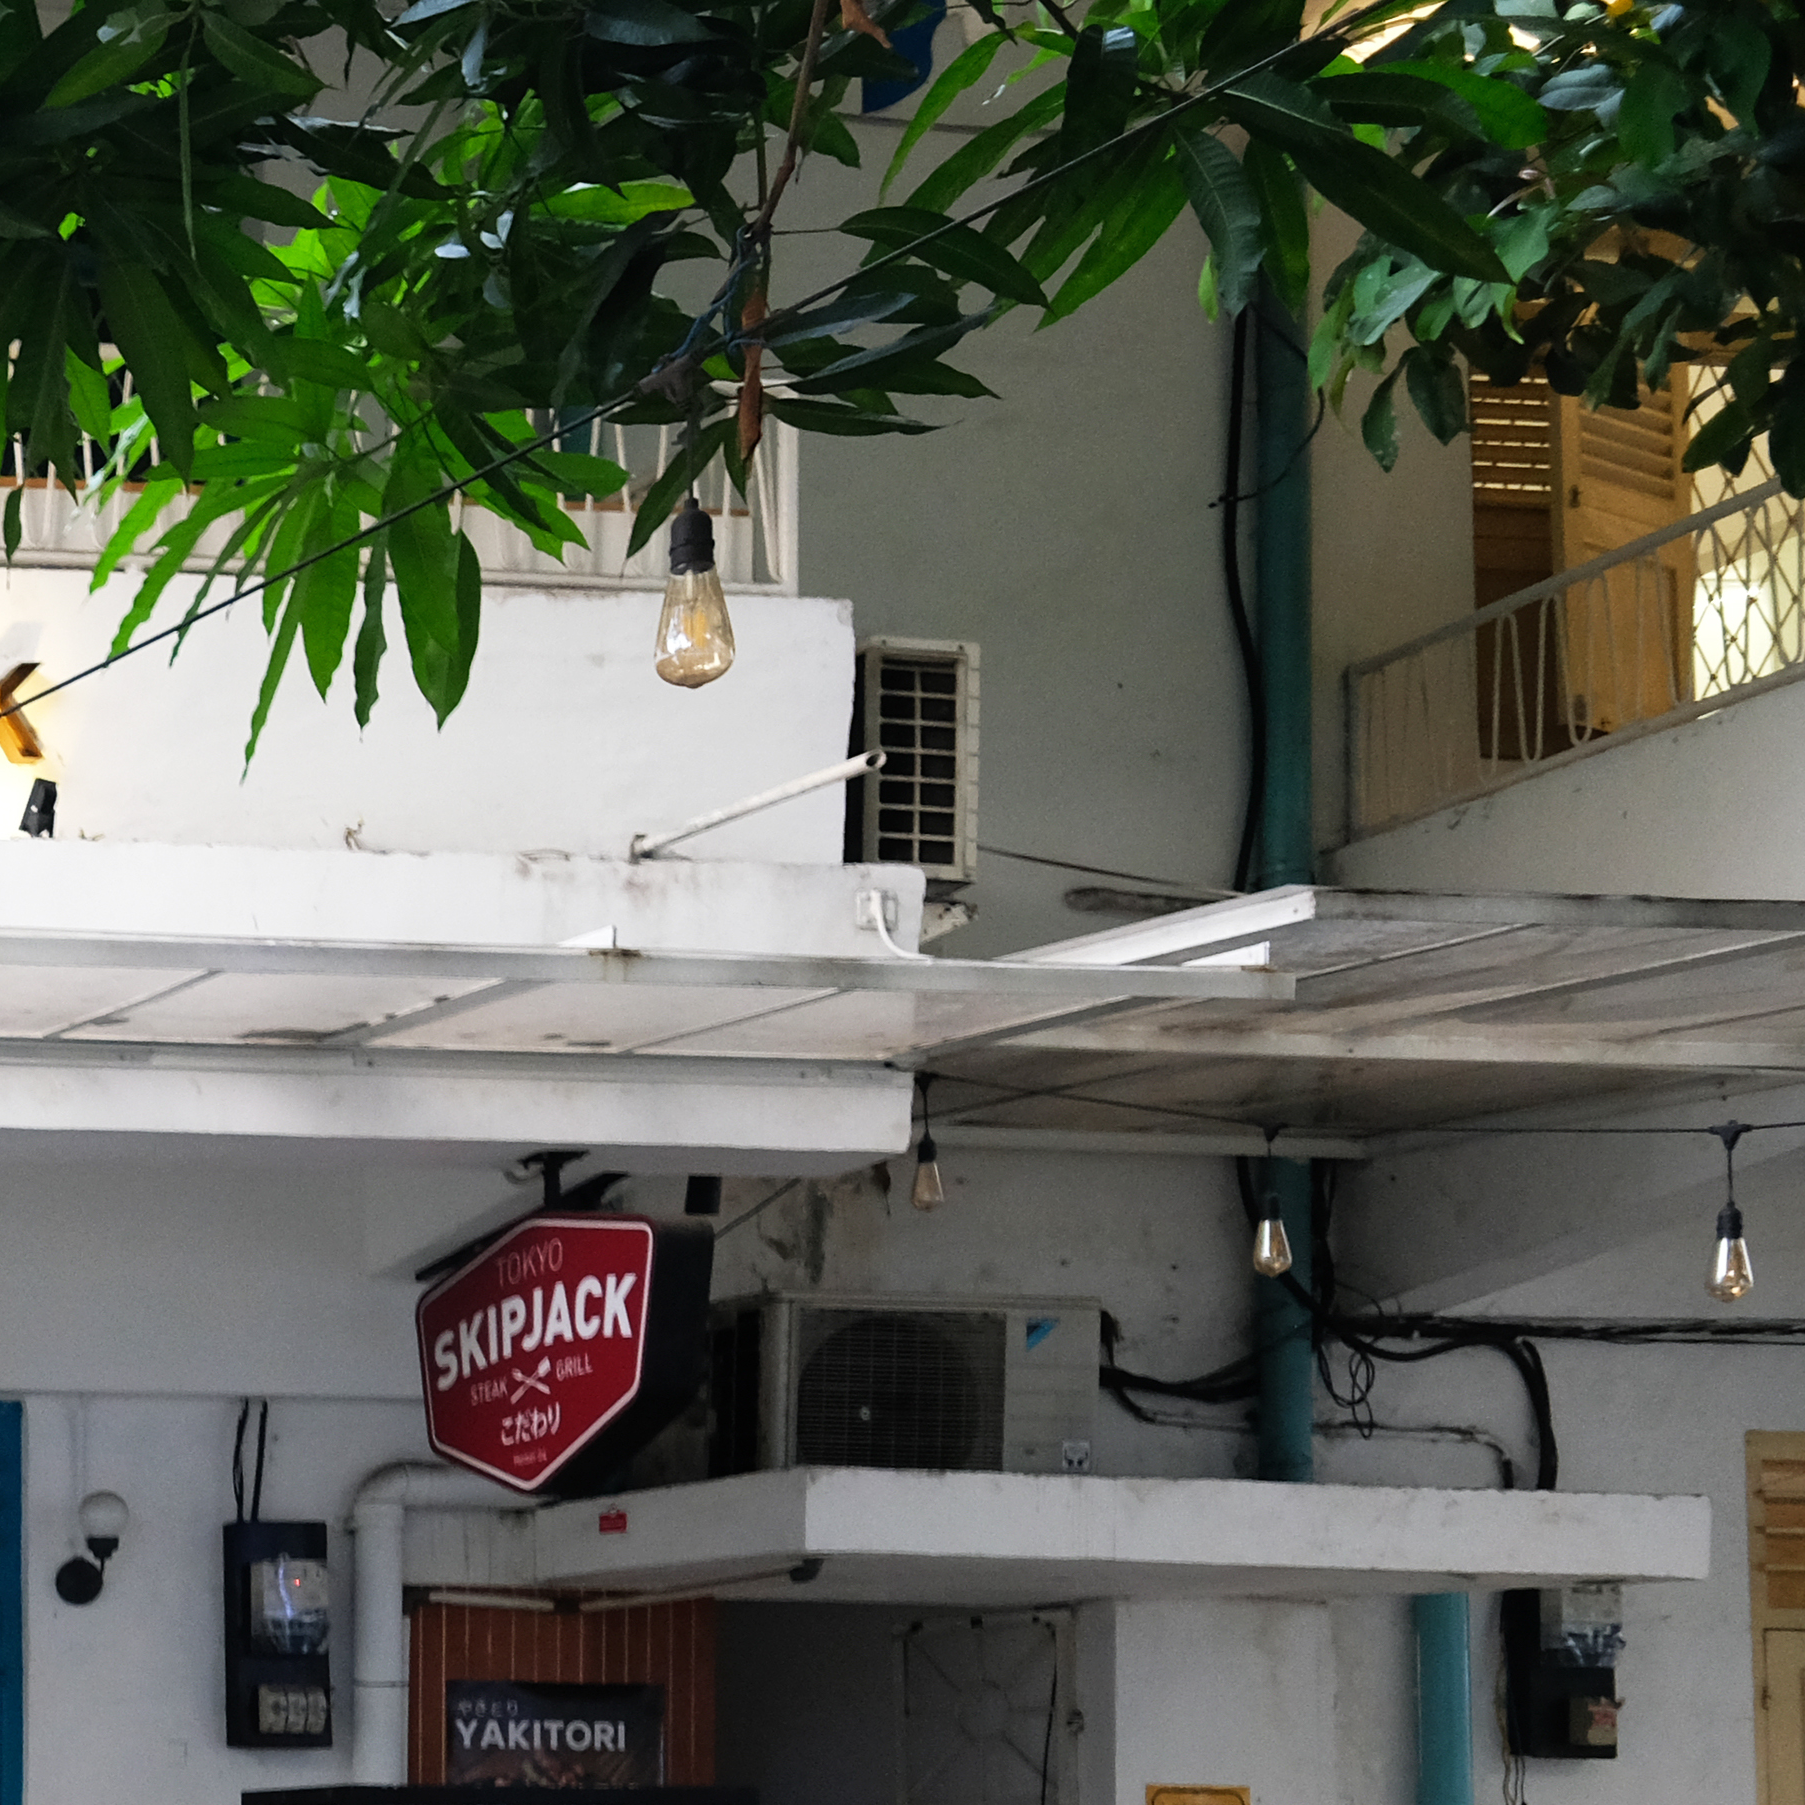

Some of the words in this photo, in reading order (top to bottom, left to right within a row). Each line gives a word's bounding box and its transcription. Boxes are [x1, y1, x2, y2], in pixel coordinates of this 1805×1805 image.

[496, 1237, 564, 1287] TOKYO
[434, 1272, 638, 1392] SKIPJACK
[470, 1378, 508, 1405] STEAK
[555, 1352, 594, 1381] GRILL
[500, 1403, 561, 1446] こだわり
[455, 1718, 625, 1752] YAKITORI
